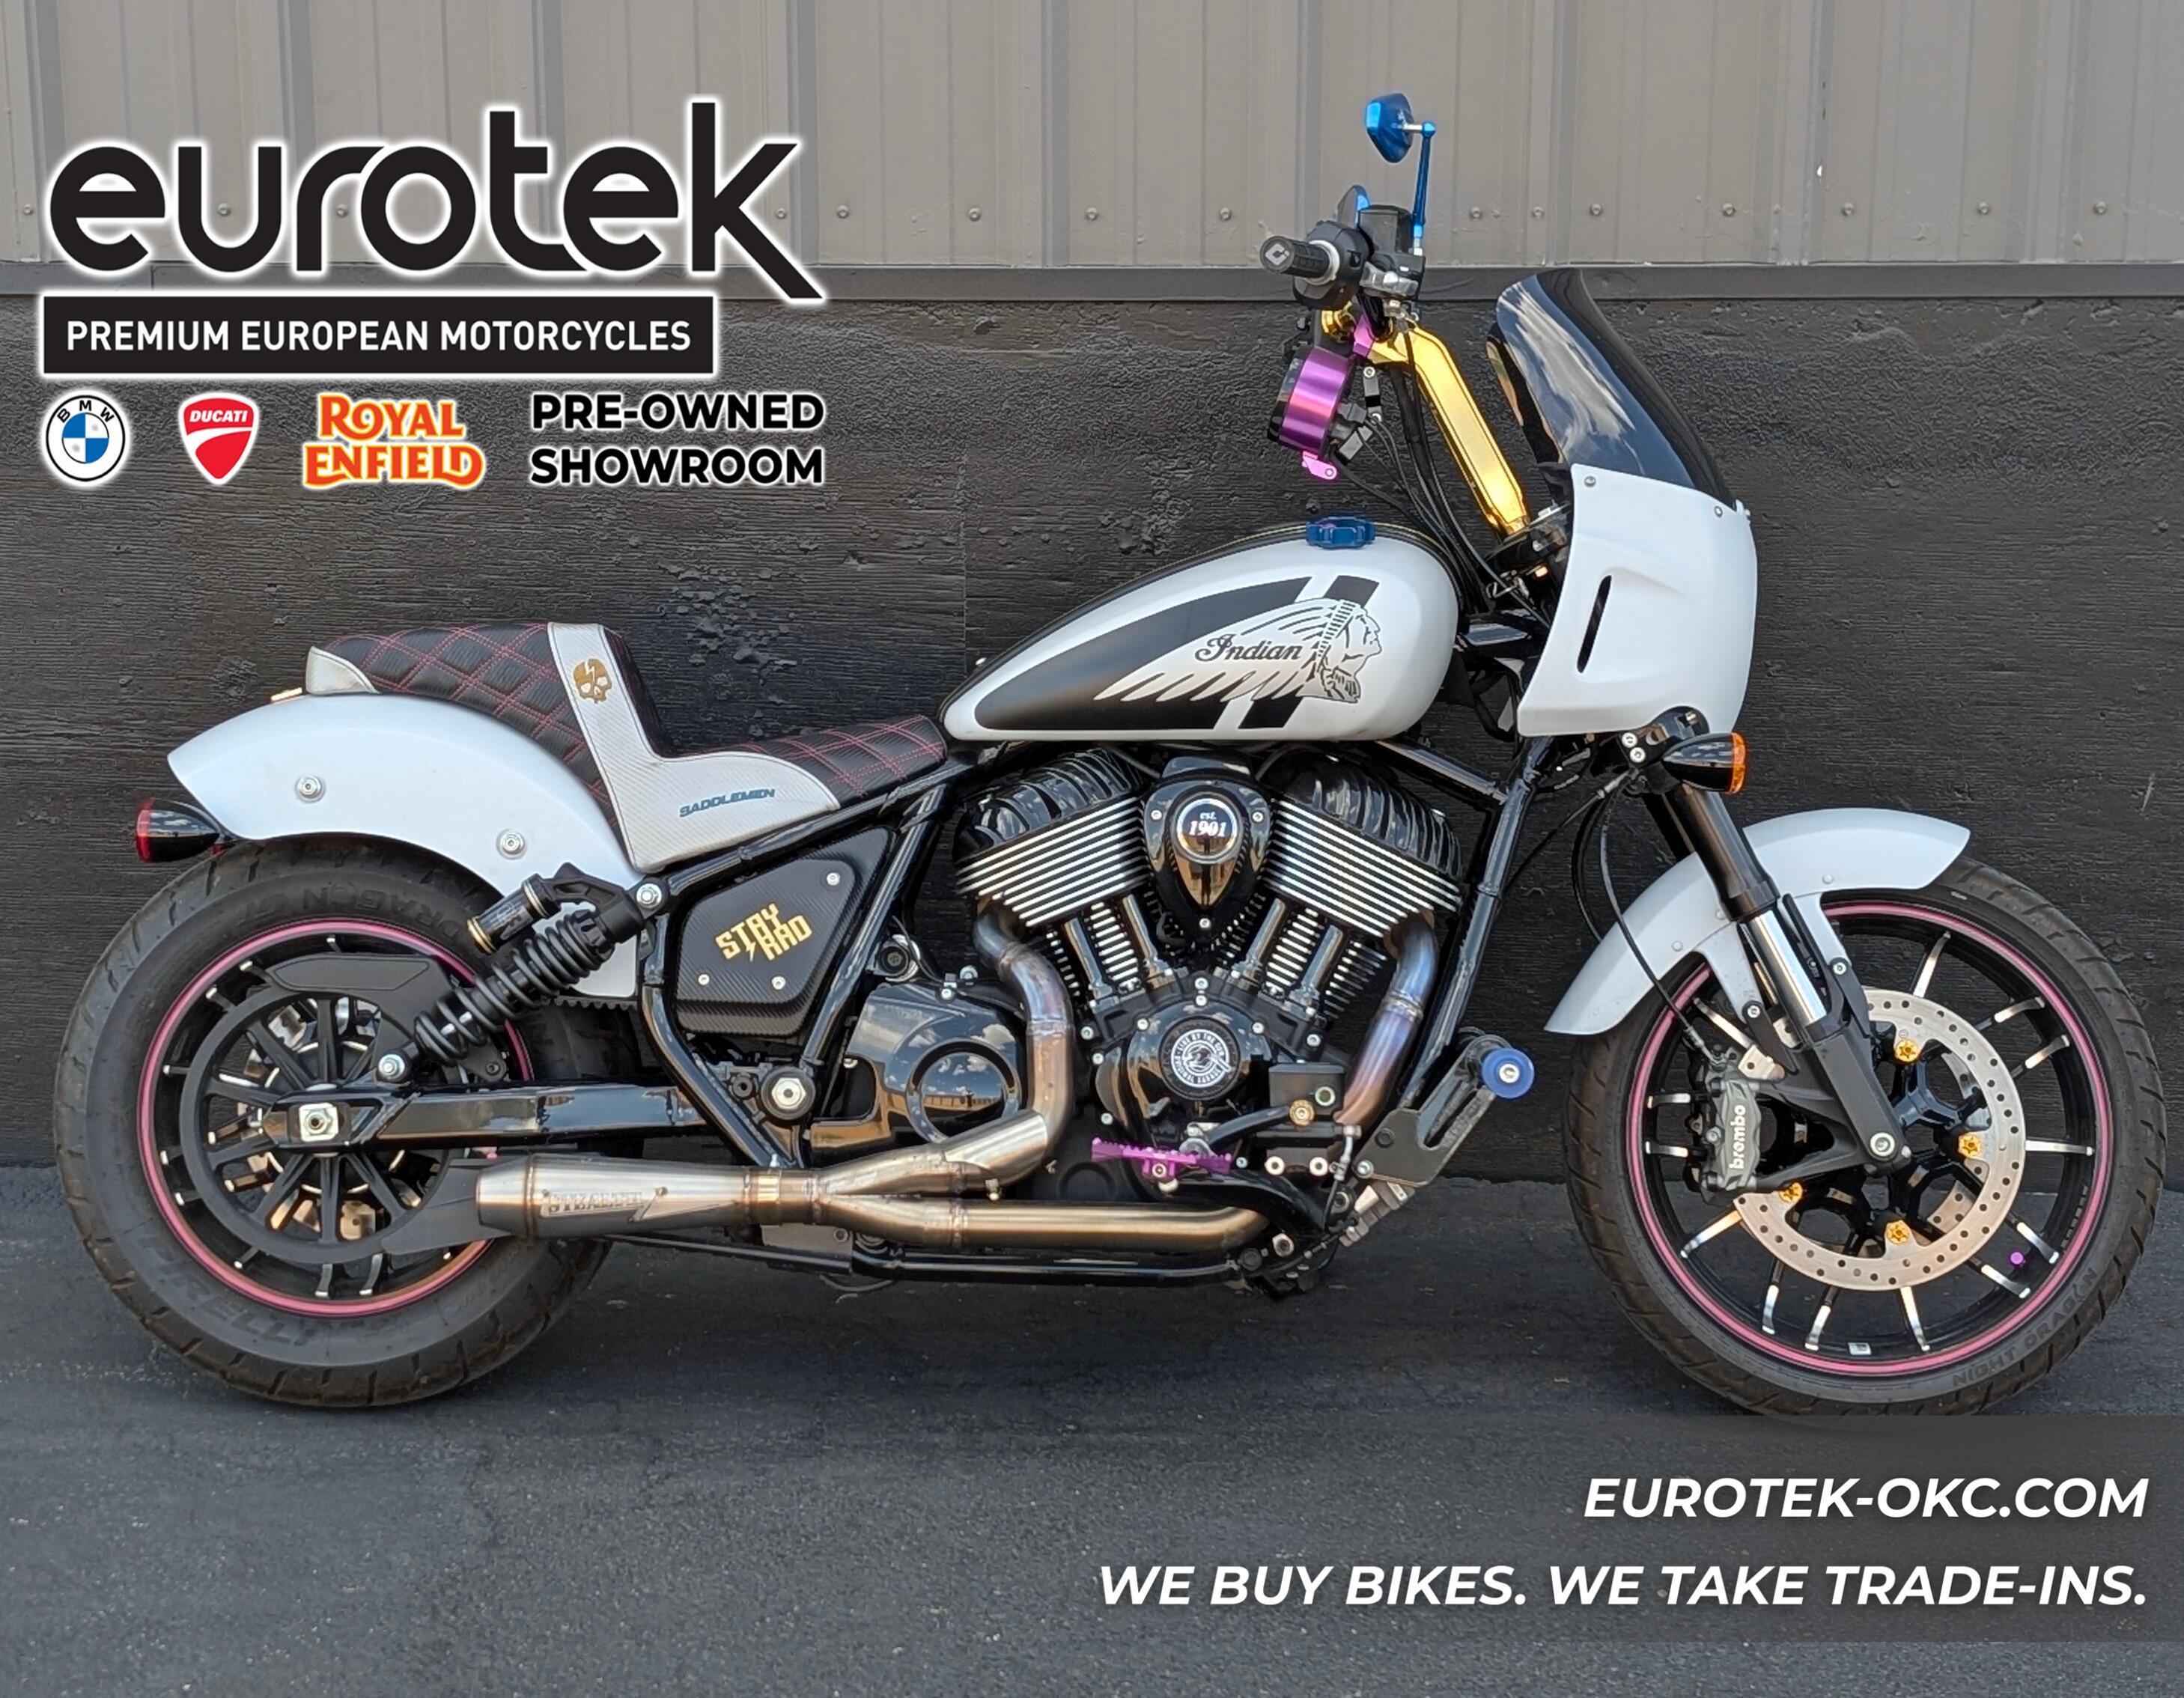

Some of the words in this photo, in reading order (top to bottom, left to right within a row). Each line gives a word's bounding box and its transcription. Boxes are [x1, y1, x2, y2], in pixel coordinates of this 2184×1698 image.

[1195, 633, 1304, 662] Indian
[679, 788, 776, 818] SADDLEMEN
[1188, 820, 1227, 838] 1901
[715, 903, 779, 961] STAY
[762, 915, 813, 961] RAD
[1952, 1348, 2017, 1387] NIGHT
[2023, 1267, 2099, 1351] DRAGON
